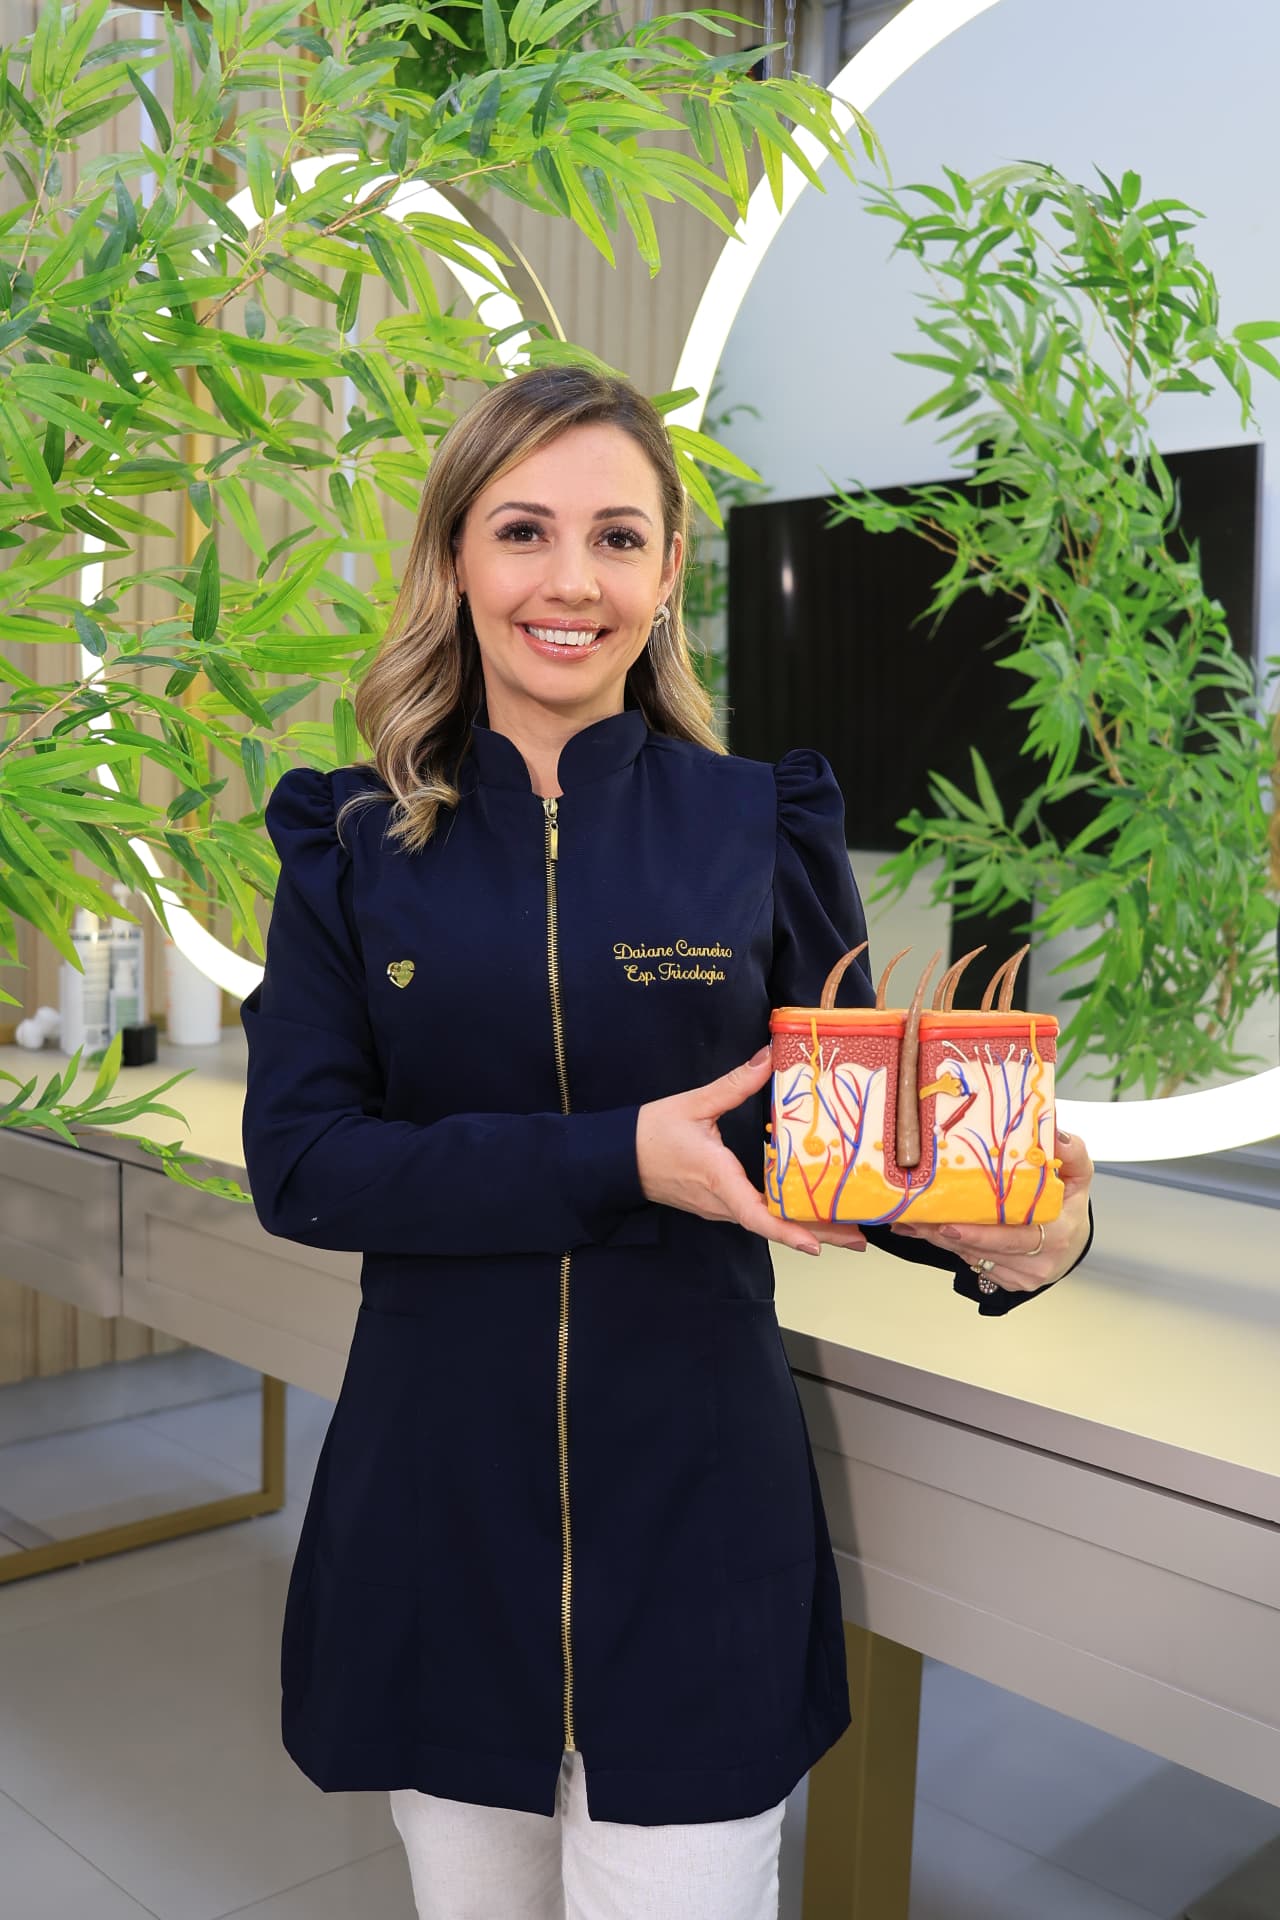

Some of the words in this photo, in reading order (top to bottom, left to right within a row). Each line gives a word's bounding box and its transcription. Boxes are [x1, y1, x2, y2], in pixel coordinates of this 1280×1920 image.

[613, 943, 674, 960] Daiane
[676, 939, 732, 958] Carneiro
[623, 964, 656, 986] Esp.
[658, 962, 726, 986] Tricologia
